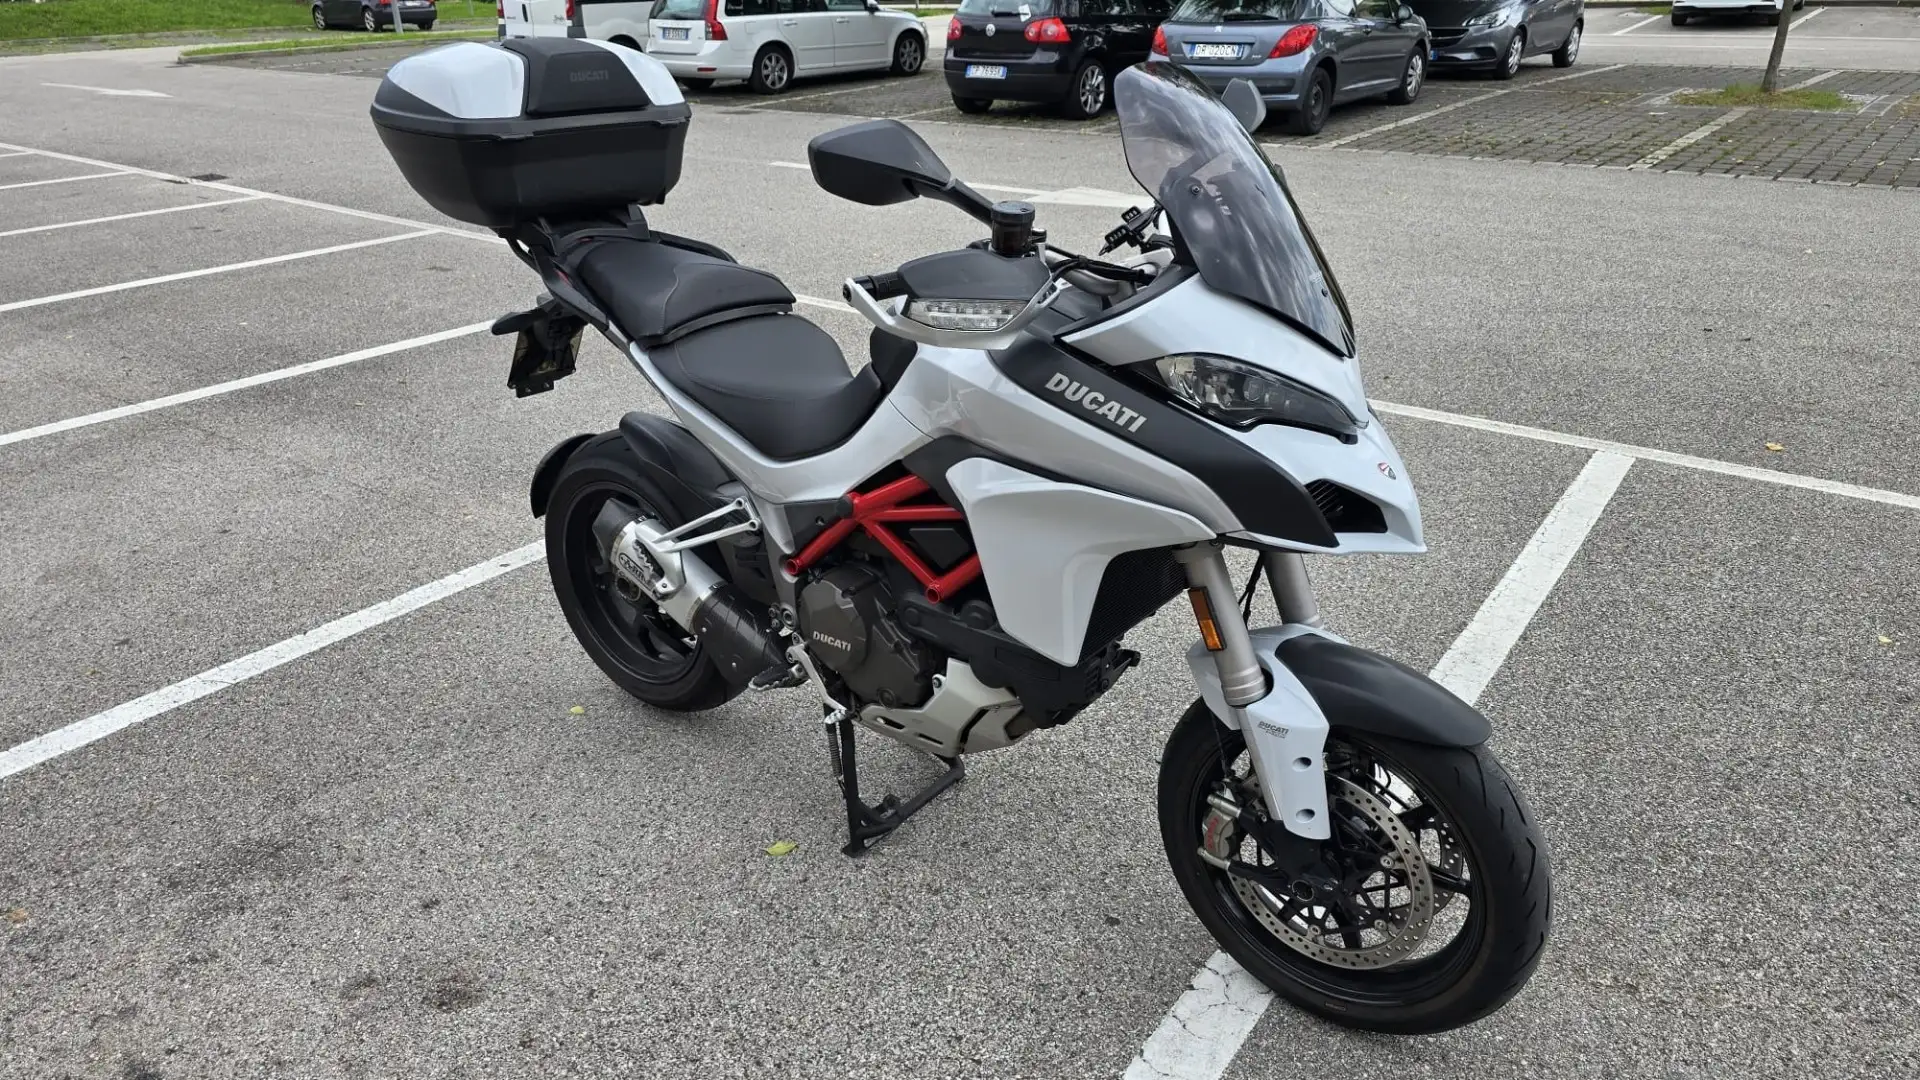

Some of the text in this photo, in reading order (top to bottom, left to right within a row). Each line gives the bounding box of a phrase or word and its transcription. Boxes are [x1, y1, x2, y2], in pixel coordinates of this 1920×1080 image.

[570, 70, 609, 82] DUCATI
[1044, 372, 1147, 433] DUCATI
[813, 630, 851, 652] DUCATI
[1257, 721, 1289, 734] DUCATI
